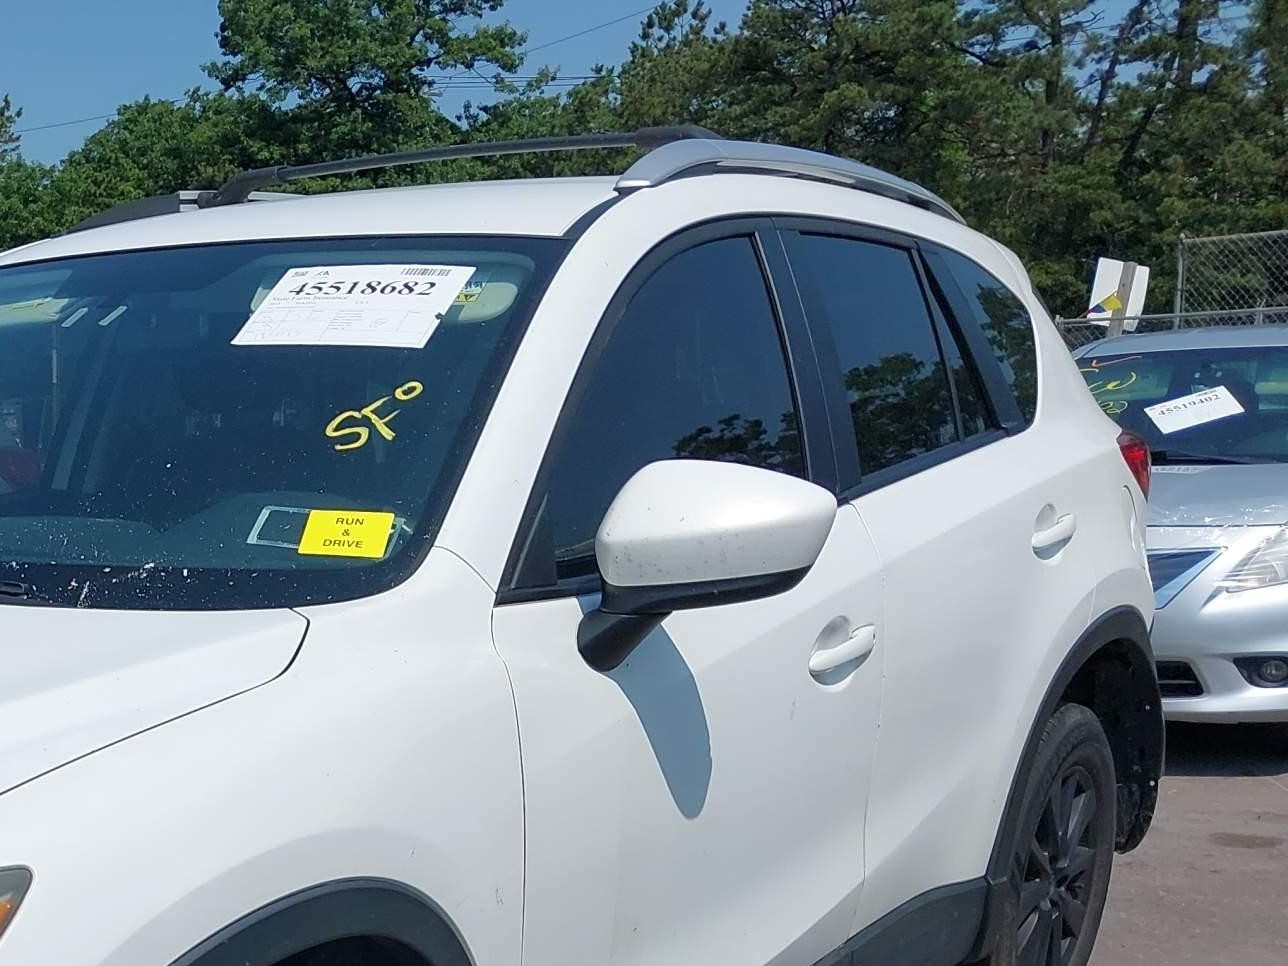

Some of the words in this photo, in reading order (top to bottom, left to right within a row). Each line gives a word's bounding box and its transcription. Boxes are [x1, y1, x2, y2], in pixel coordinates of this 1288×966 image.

[289, 279, 437, 296] 45518682
[335, 516, 365, 526] RUN
[341, 528, 351, 537] &
[322, 538, 364, 549] DRIVE
